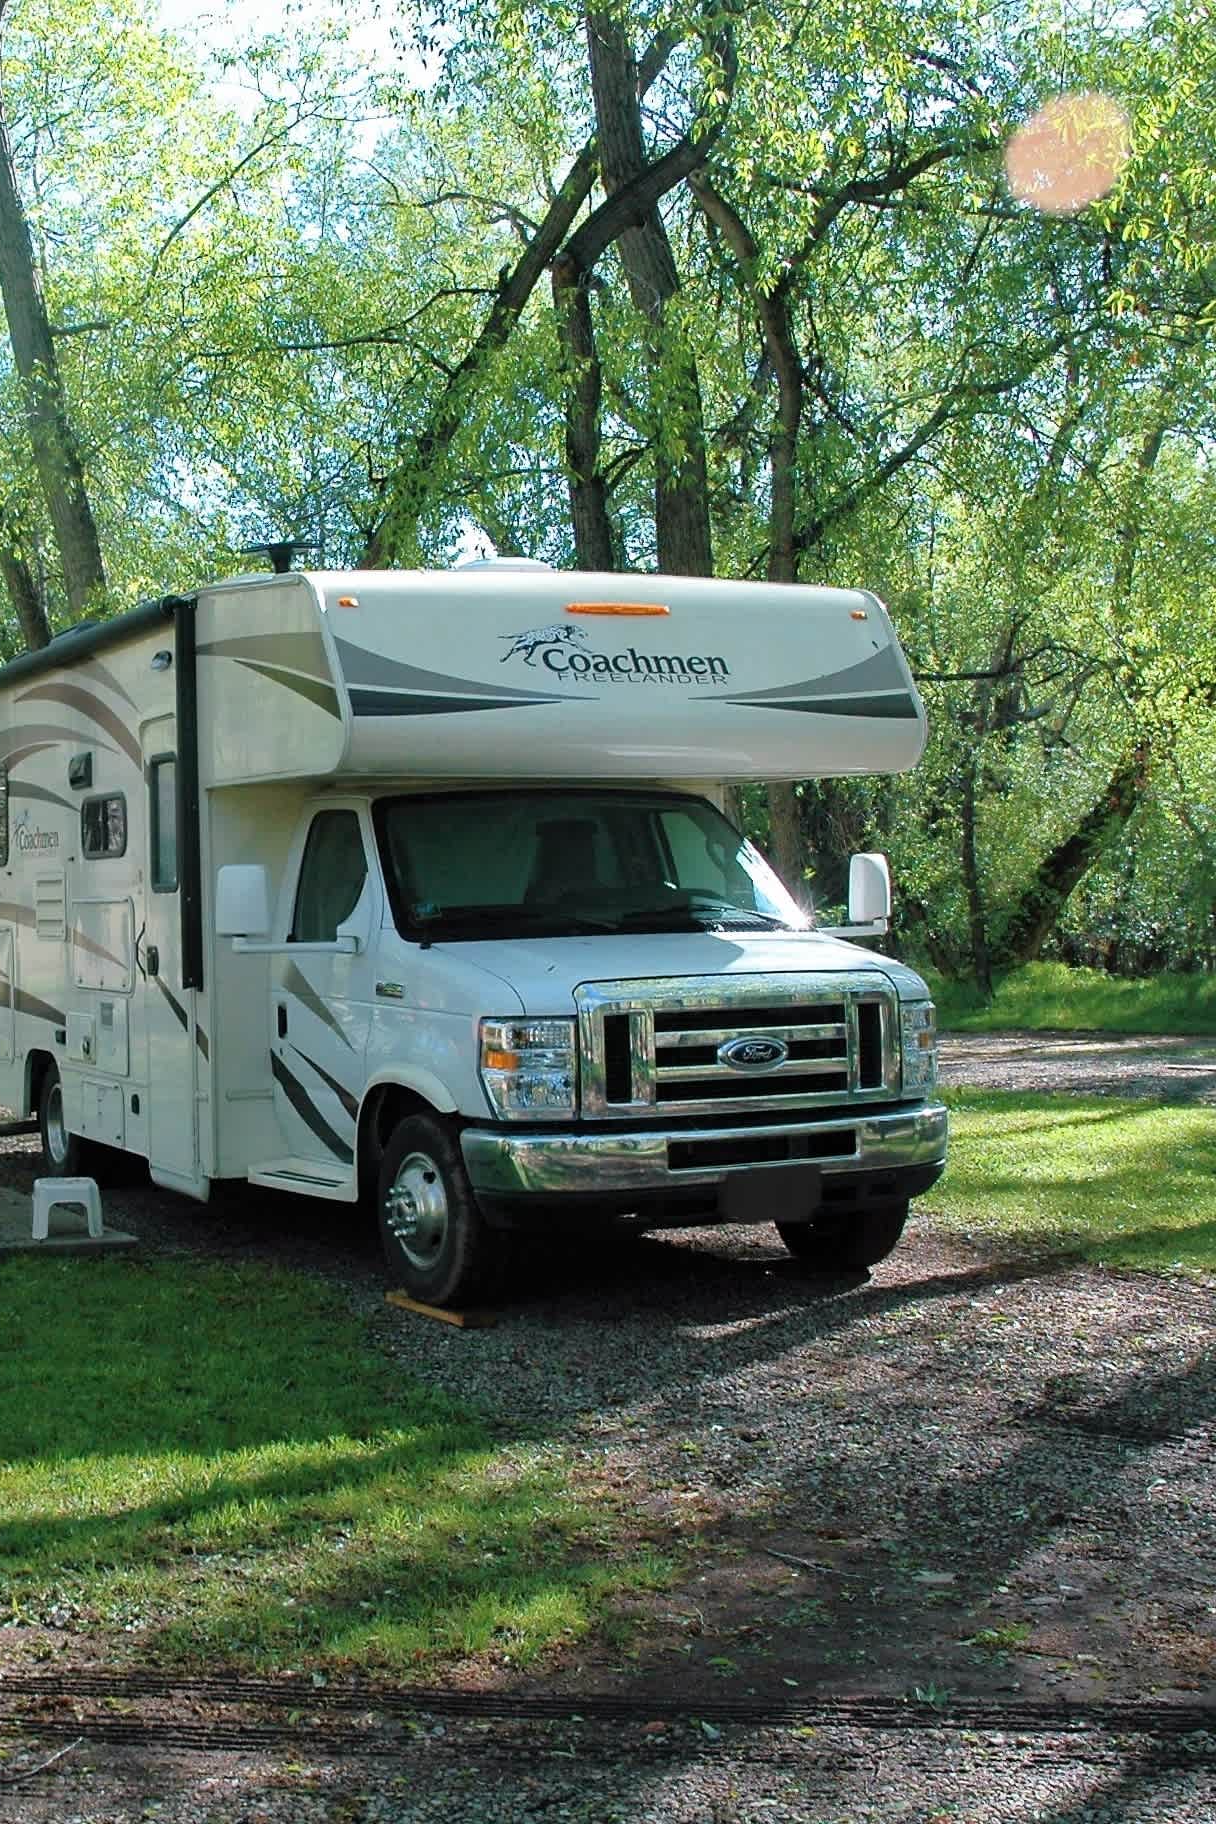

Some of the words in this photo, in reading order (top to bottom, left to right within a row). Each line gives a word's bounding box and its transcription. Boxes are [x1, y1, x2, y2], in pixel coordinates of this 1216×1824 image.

[542, 648, 730, 675] Coachmen
[558, 672, 728, 685] FREELANDER
[744, 1045, 772, 1060] Ford
